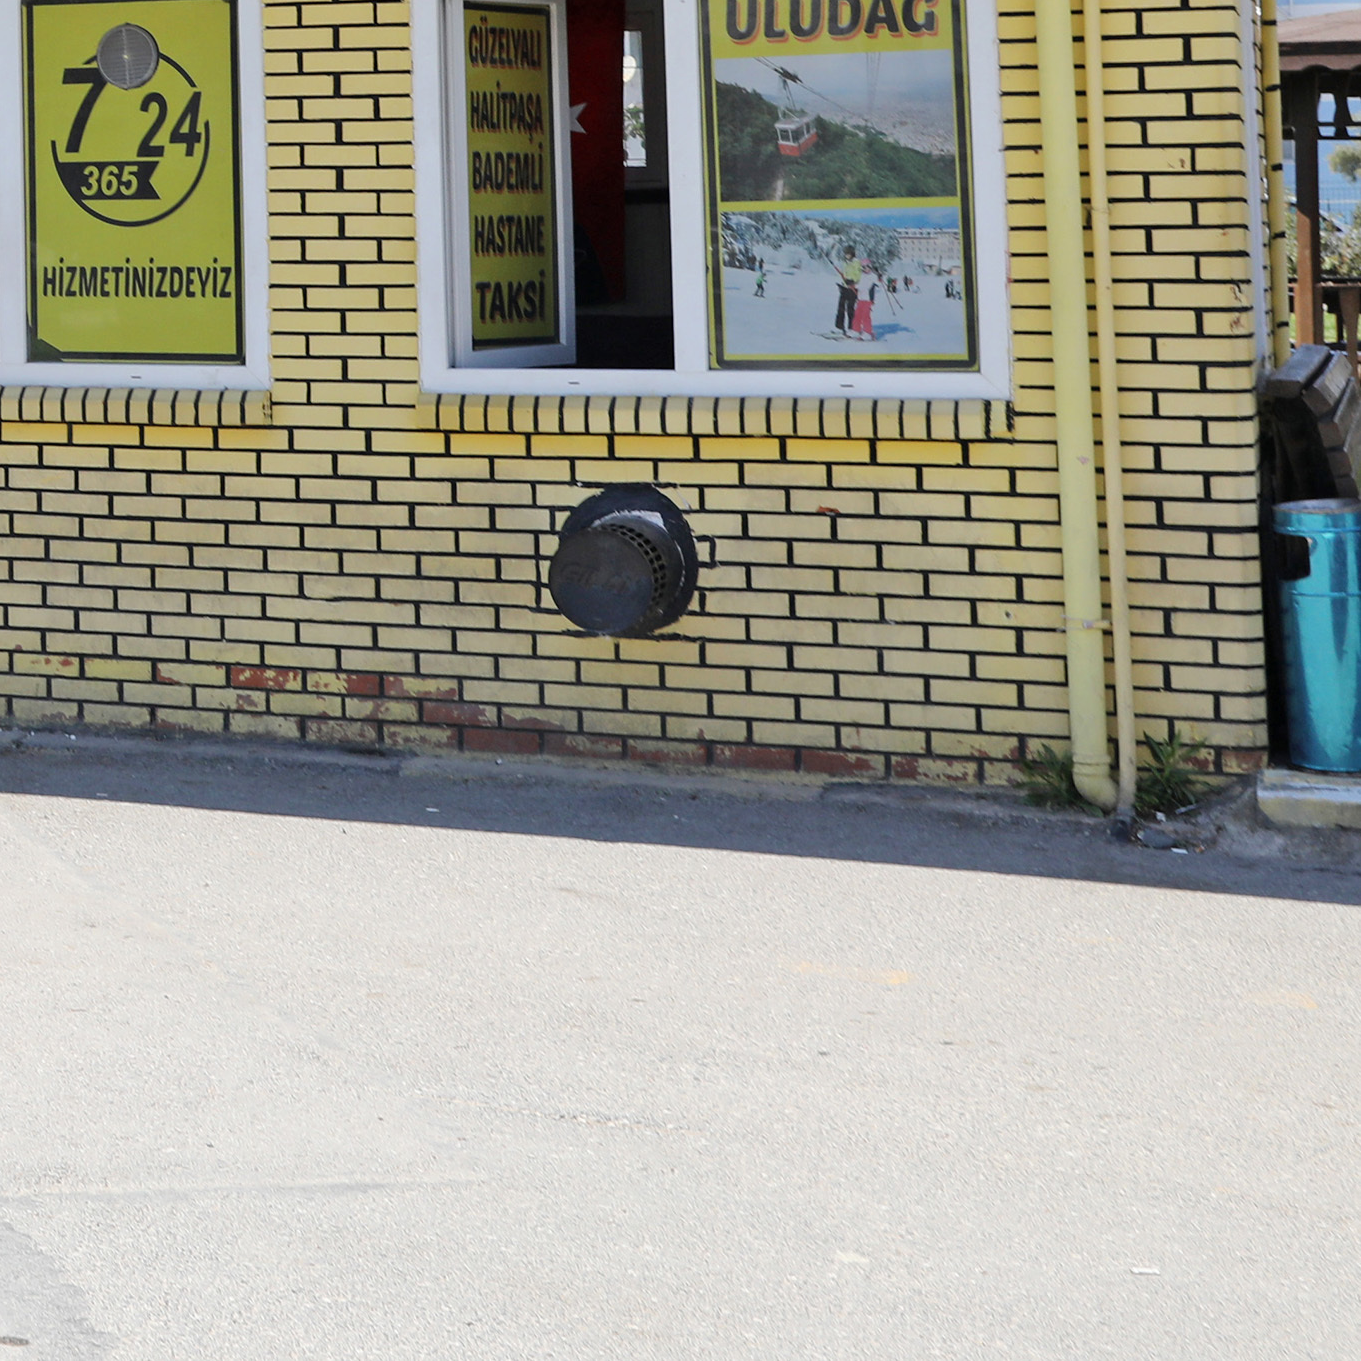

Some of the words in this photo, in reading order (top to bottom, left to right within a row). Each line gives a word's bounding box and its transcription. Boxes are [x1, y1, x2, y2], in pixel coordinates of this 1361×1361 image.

[469, 16, 542, 70] GÜZELYALI
[62, 67, 109, 154] 7
[136, 91, 203, 158] 24
[470, 80, 544, 143] HALİTPAŞA
[80, 165, 139, 197] 365
[472, 142, 545, 194] BADEMLİ
[474, 214, 546, 258] HASTANE
[42, 256, 233, 299] HİZMETİNİZDEYİZ
[475, 269, 547, 324] TAKSİ
